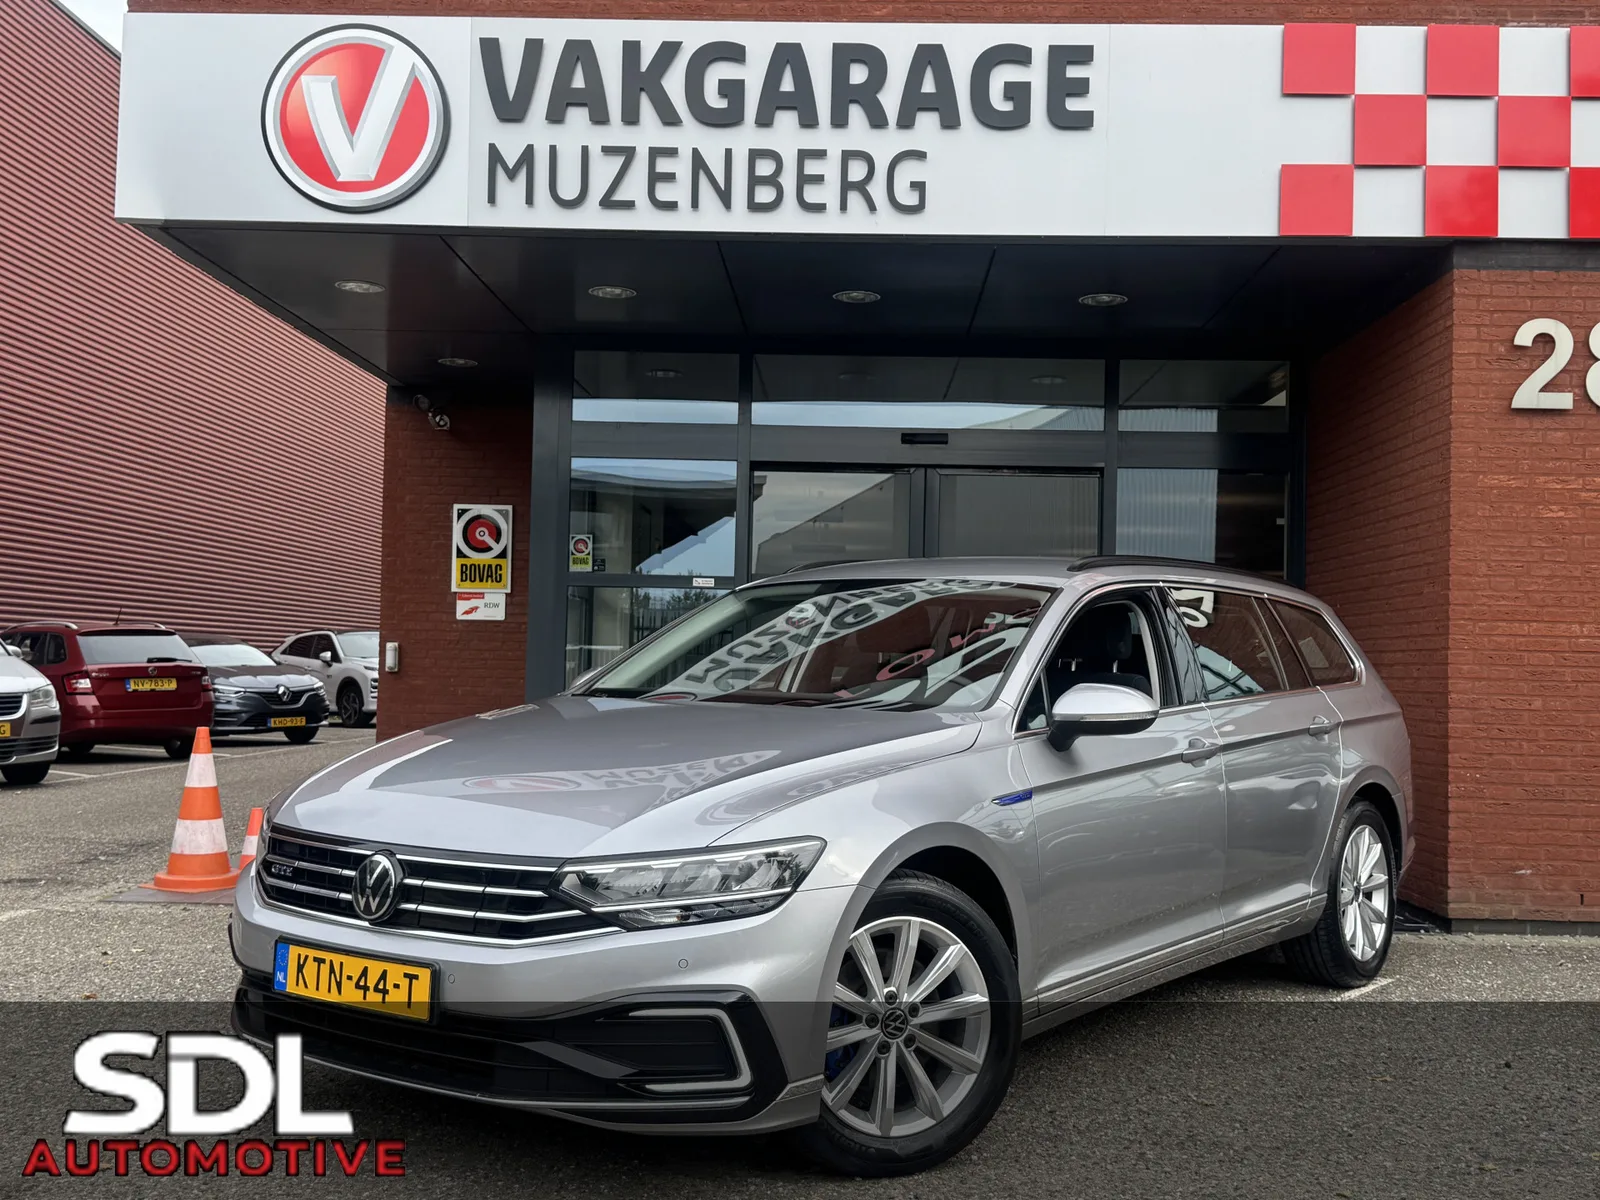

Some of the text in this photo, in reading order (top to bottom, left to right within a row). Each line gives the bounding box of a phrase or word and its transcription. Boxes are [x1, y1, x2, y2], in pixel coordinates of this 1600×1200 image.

[478, 36, 1095, 131] VAKGARAGE
[487, 142, 927, 214] MUZENBERG
[1510, 317, 1600, 410] 2
[460, 563, 503, 583] BOVAG
[276, 971, 286, 983] NL
[296, 953, 419, 1008] KTN-44-T
